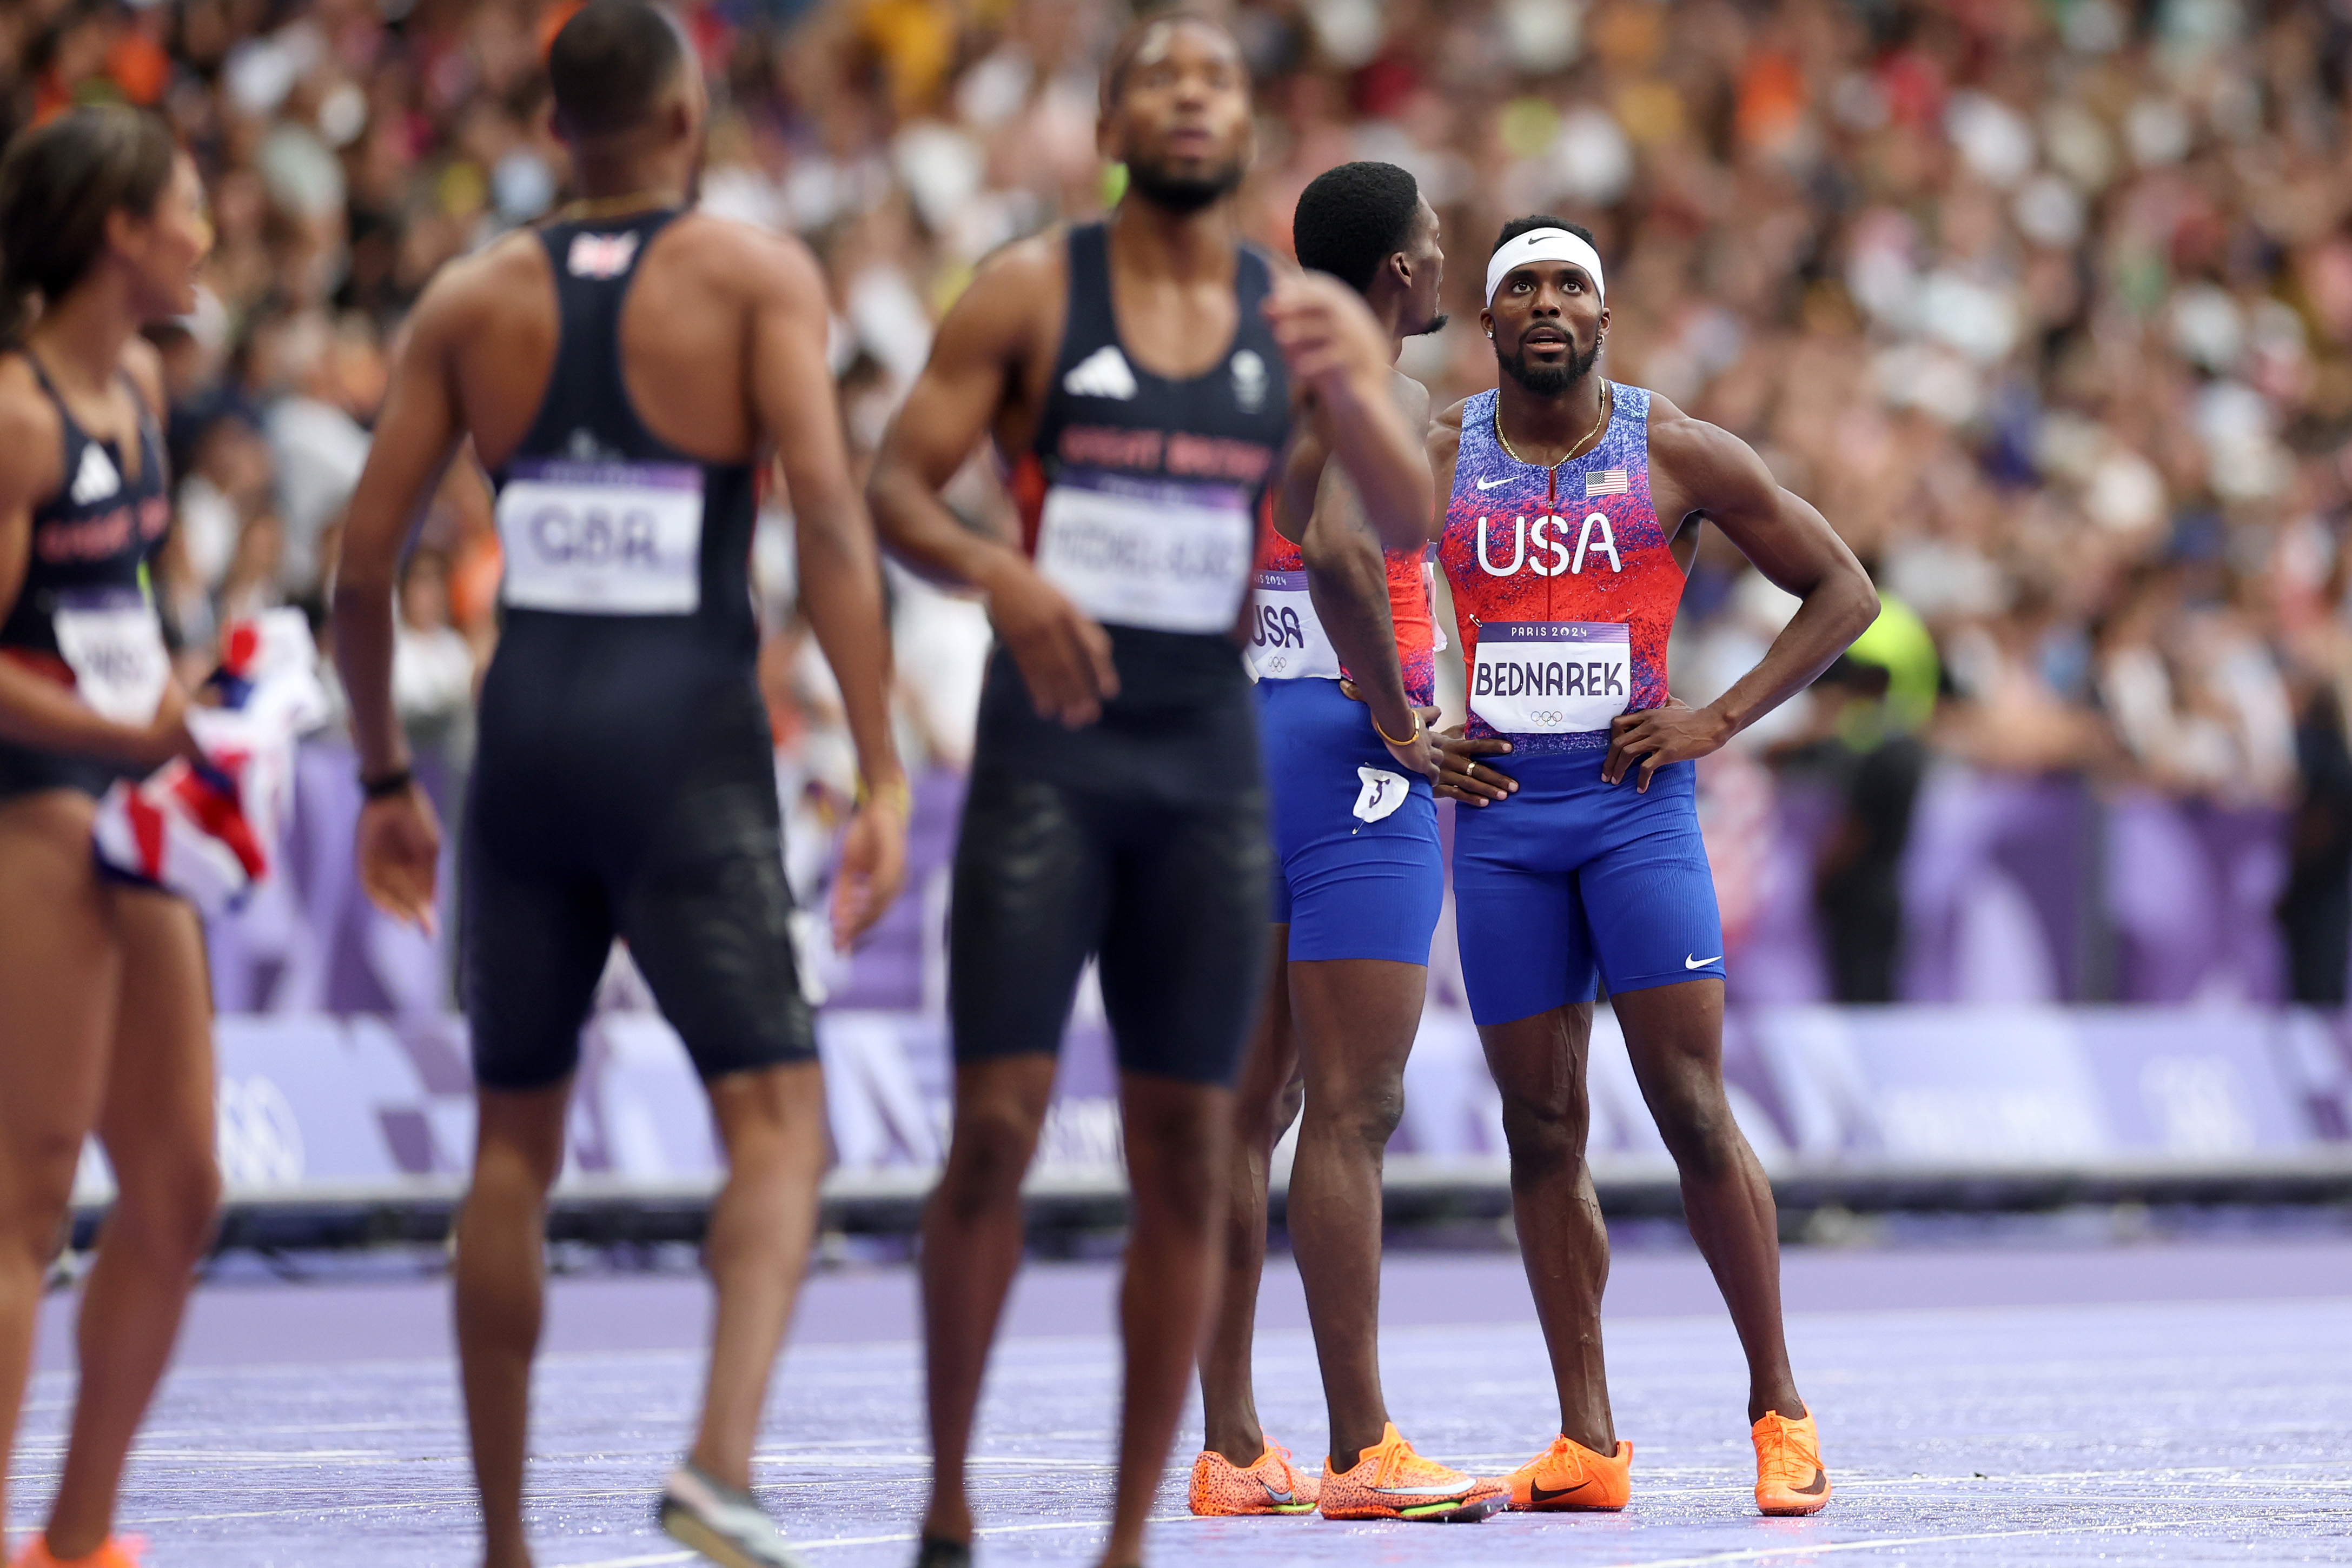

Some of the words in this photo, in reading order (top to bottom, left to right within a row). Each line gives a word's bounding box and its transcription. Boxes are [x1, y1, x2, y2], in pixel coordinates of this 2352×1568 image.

[1478, 513, 1621, 576] USA
[1265, 575, 1287, 586] 2024
[1252, 604, 1304, 649] USA
[1552, 627, 1587, 637] 2024
[1475, 662, 1623, 696] BEDNAREK
